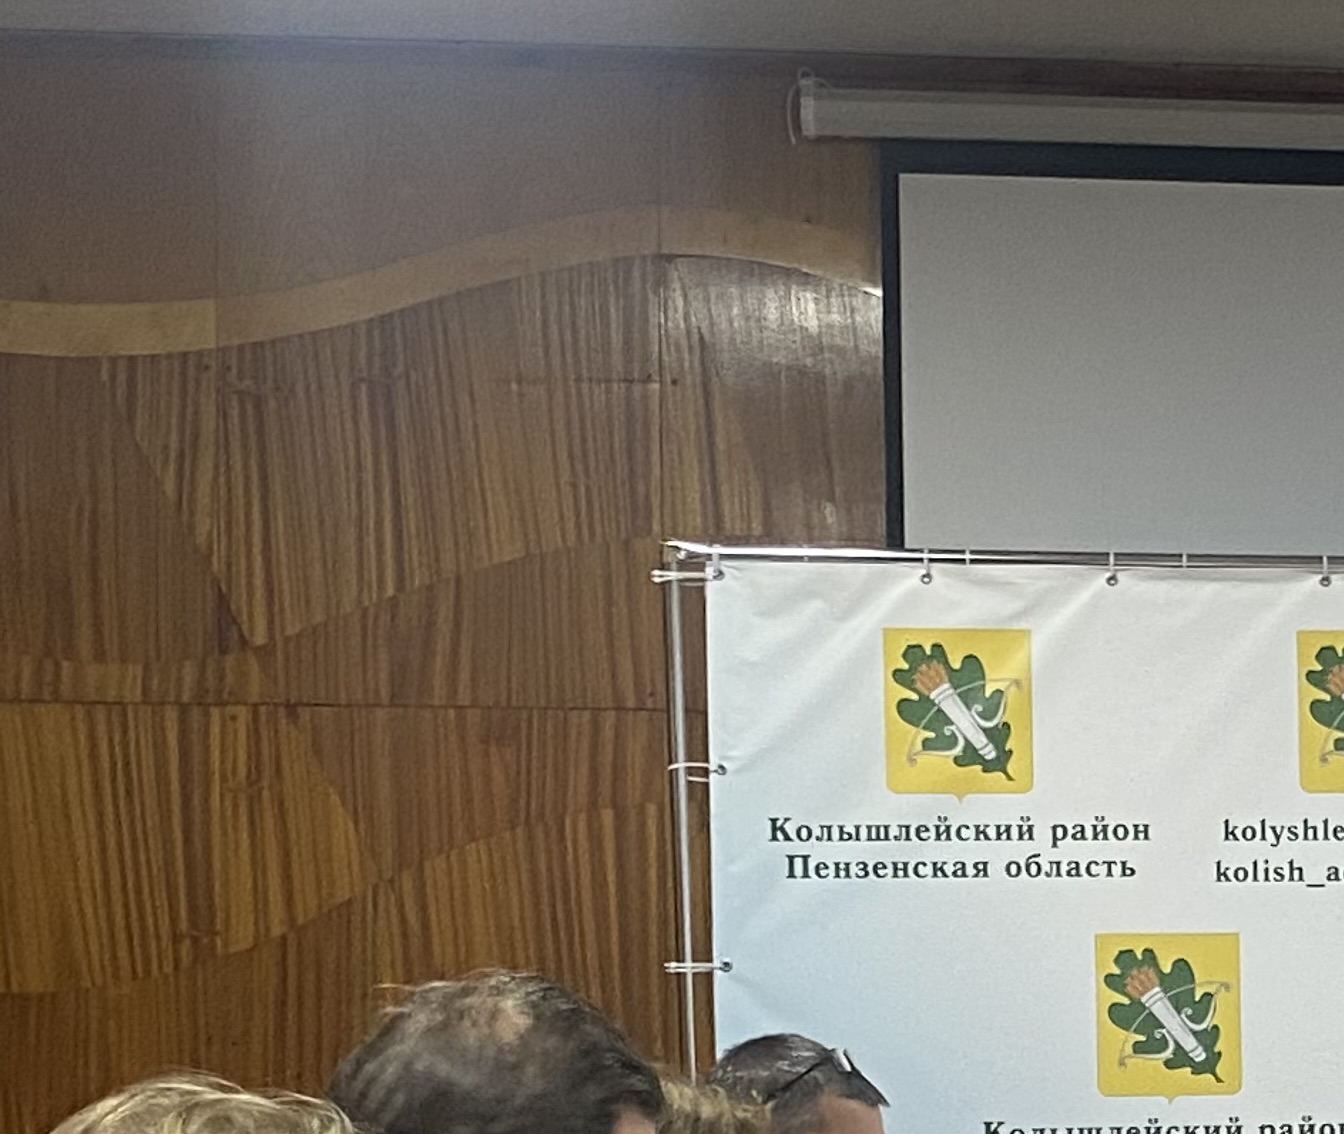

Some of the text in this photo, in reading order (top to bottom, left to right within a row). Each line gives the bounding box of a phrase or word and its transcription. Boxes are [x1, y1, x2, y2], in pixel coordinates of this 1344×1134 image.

[768, 815, 1150, 848] Колышлейский район
[785, 853, 1137, 879] Пензенская область
